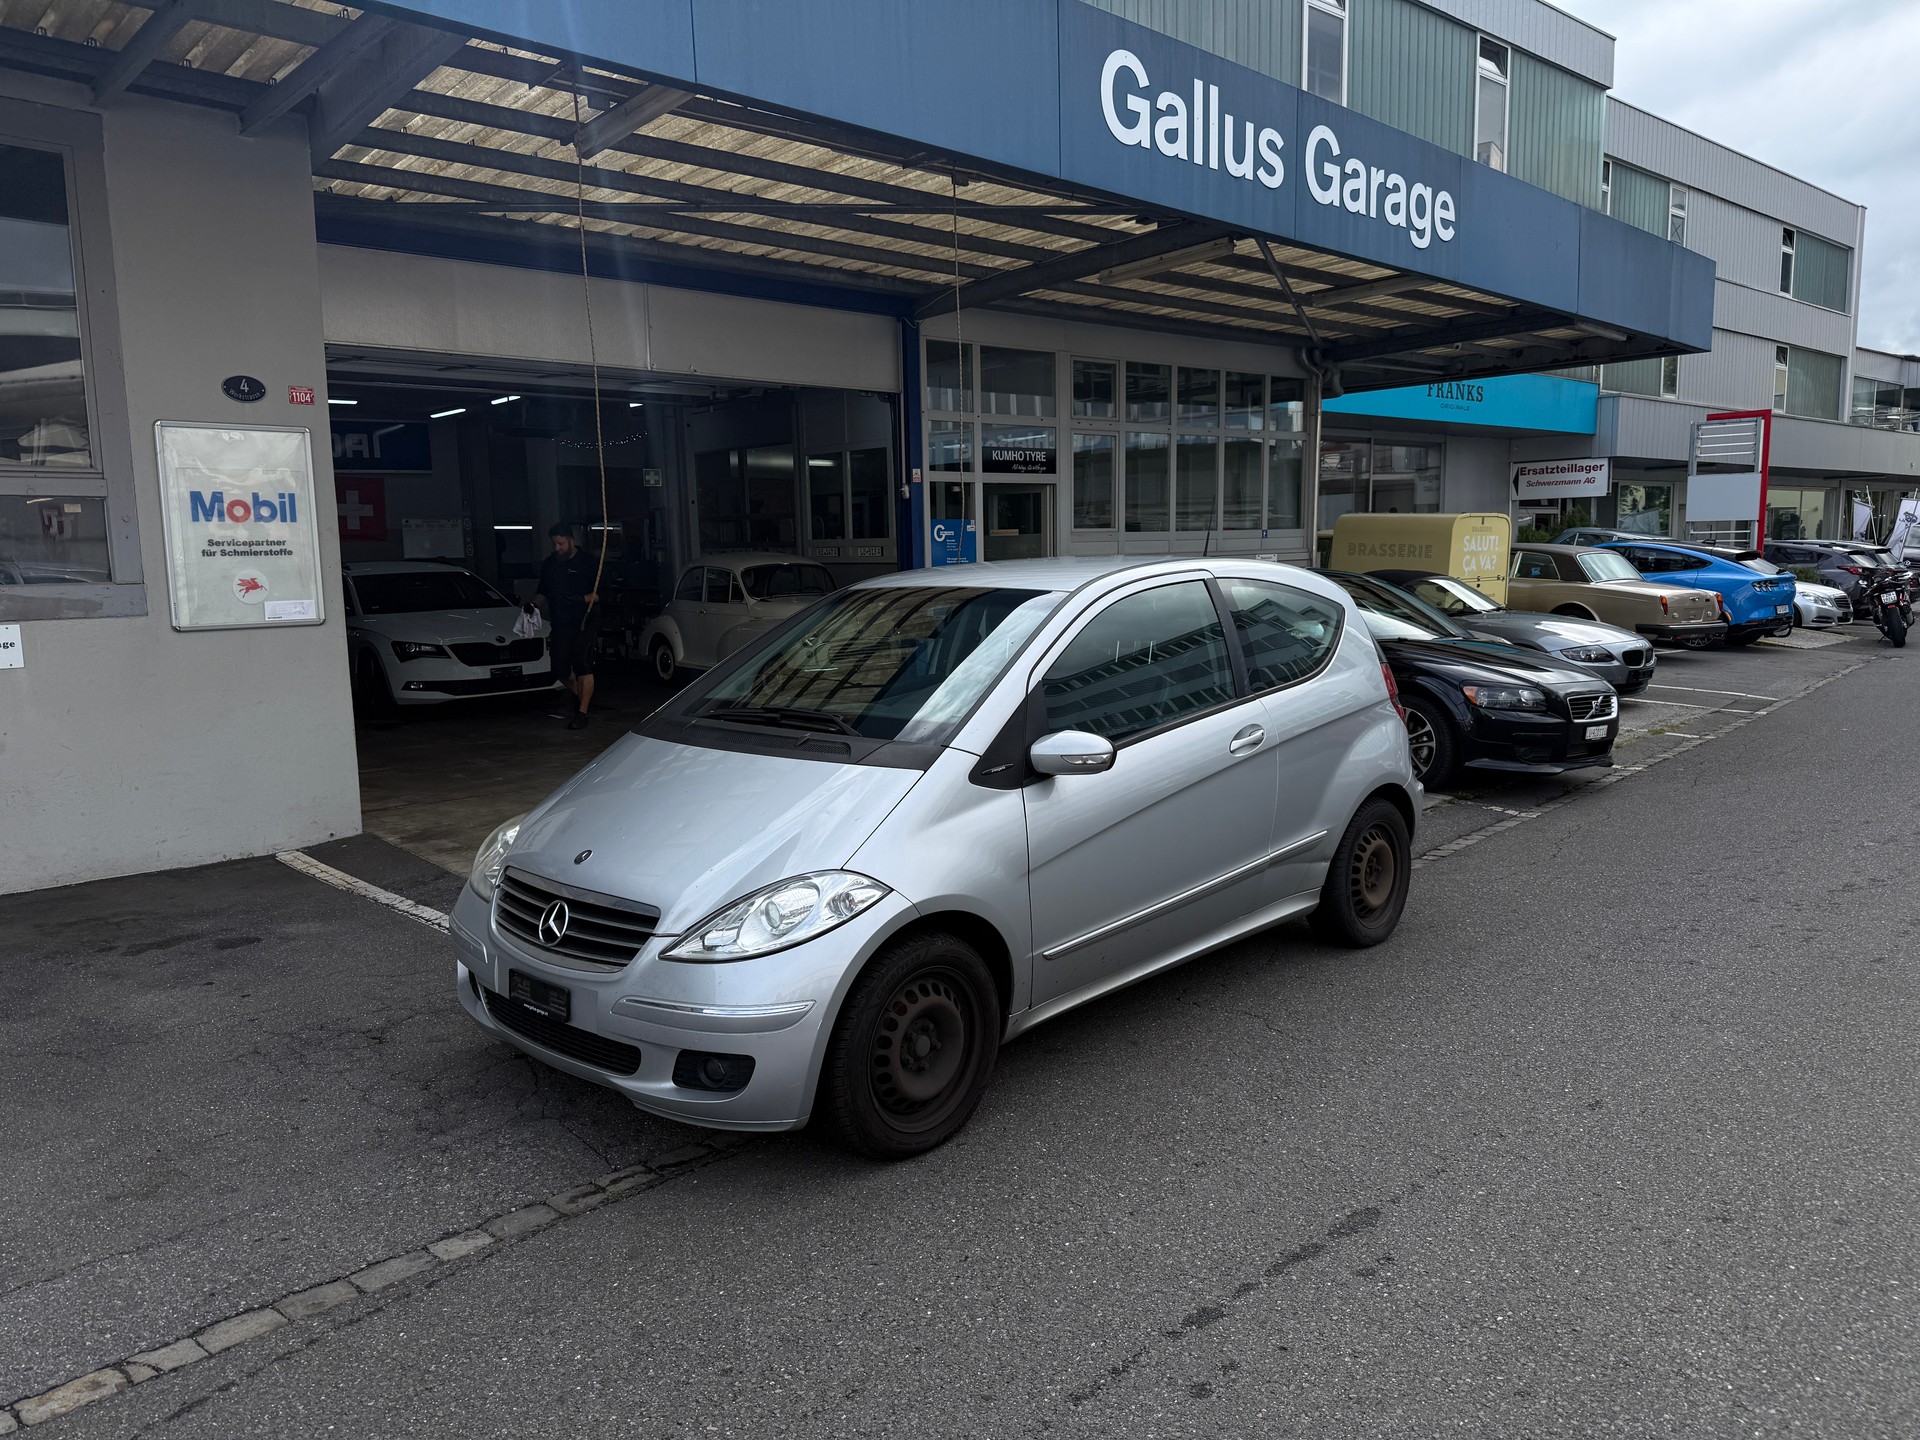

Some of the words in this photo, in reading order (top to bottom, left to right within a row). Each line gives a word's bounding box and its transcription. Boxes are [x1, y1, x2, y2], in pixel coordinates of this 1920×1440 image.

[1100, 49, 1285, 189] Gallus
[1305, 125, 1456, 249] Garage
[240, 379, 250, 393] 4
[1427, 382, 1484, 403] FRANKS
[292, 391, 311, 403] 1104
[1440, 403, 1471, 412] ORIGINALE
[992, 450, 1025, 461] KUMHO
[1025, 451, 1047, 462] TYRE
[1520, 464, 1604, 476] Ersatzteillager
[1525, 479, 1581, 488] Schwerzmann
[1583, 477, 1596, 485] AG
[189, 490, 298, 523] Mobil
[207, 538, 287, 550] Servicepartner
[1463, 535, 1499, 552] SALUT!
[202, 548, 217, 557] für
[220, 548, 293, 557] Schmierstoffe
[1347, 542, 1433, 559] BRASSERIE
[1463, 555, 1477, 577] ÇA
[1480, 554, 1497, 571] VA?
